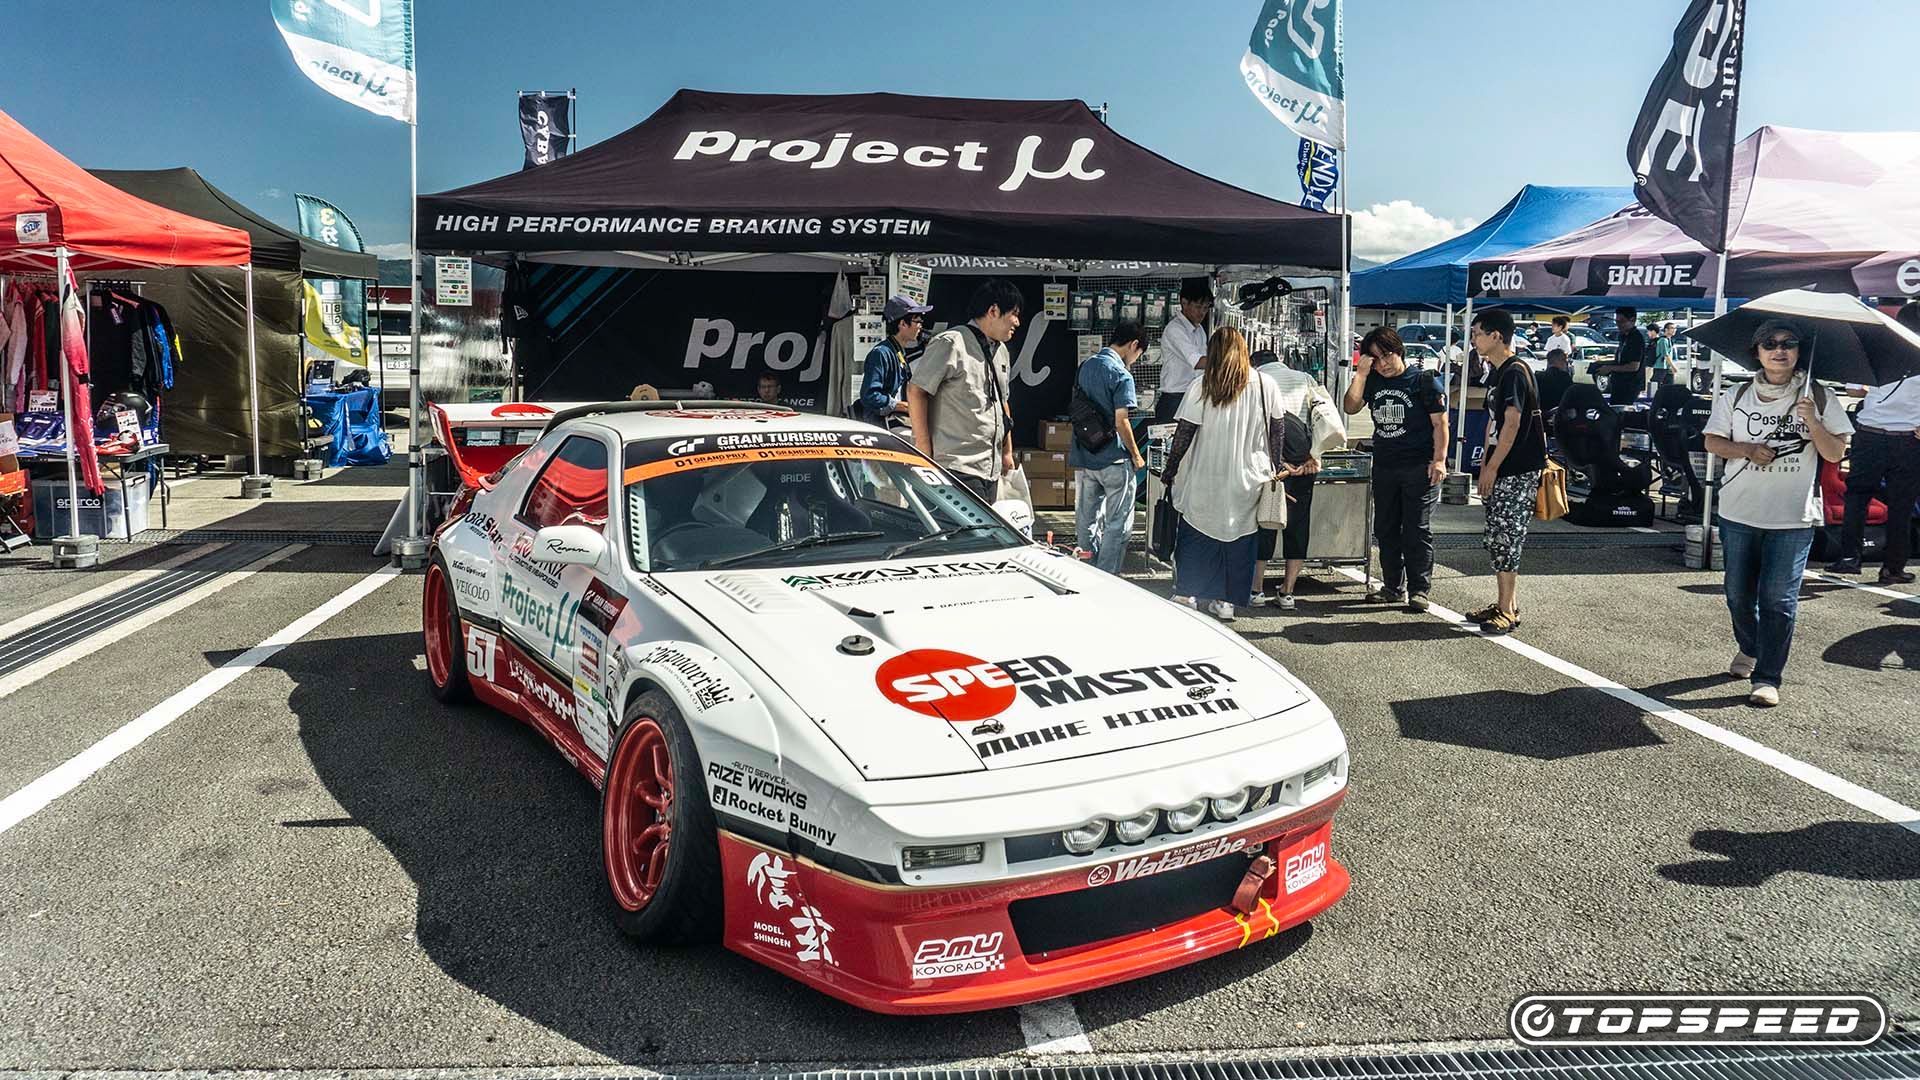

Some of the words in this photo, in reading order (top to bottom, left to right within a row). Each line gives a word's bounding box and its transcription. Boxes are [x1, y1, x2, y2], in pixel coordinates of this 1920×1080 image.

[673, 131, 988, 171] Project
[436, 215, 499, 232] HIGH
[506, 216, 700, 233] PERFORMANCE
[708, 218, 821, 234] BRAKING
[830, 219, 930, 236] SYSTEM
[1481, 265, 1523, 291] edirb
[1607, 265, 1693, 286] BRIDE
[716, 434, 764, 446] GRAN
[767, 432, 839, 444] TURISMO
[674, 458, 693, 468] D1
[694, 454, 725, 464] GRAND
[726, 452, 748, 460] PRIX
[757, 450, 776, 459] D1
[56, 498, 101, 508] sprco
[456, 579, 490, 602] VEICOLO
[501, 573, 555, 639] Project
[891, 655, 1073, 703] SPEED
[1020, 663, 1238, 708] MASTER
[976, 719, 1092, 758] MAKE
[707, 762, 745, 787] RIZE
[748, 775, 808, 810] WORKS
[728, 791, 786, 823] Rocket
[789, 811, 837, 846] Bunny
[1114, 837, 1247, 882] Watanabe
[753, 932, 792, 949] SHINGEN
[915, 960, 984, 976] KOYORAD
